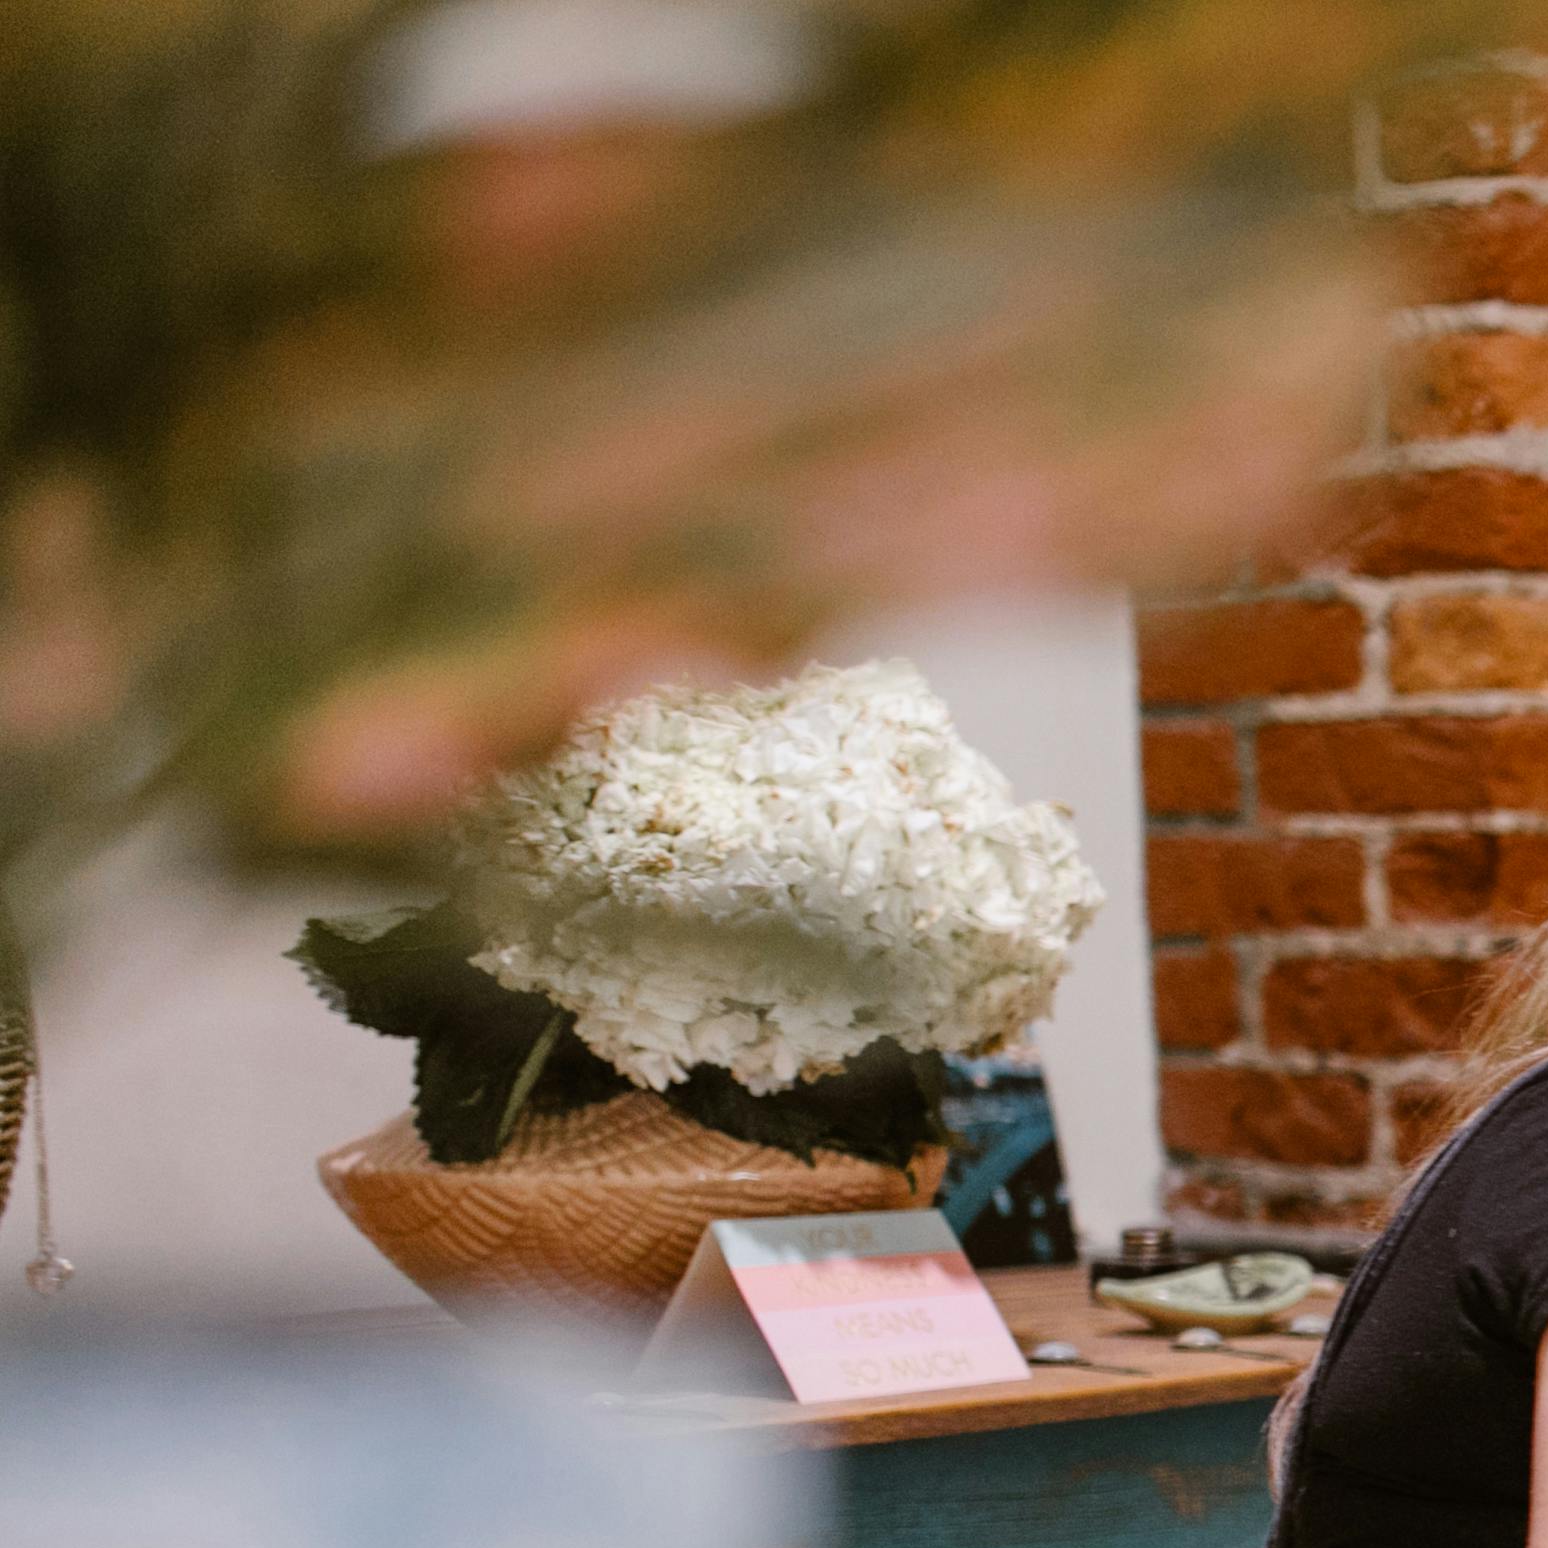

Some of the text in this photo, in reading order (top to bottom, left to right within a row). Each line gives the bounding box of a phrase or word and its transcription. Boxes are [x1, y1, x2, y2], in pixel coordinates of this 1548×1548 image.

[834, 1308, 935, 1339] MEANS
[839, 1350, 972, 1386] SO MUCH
